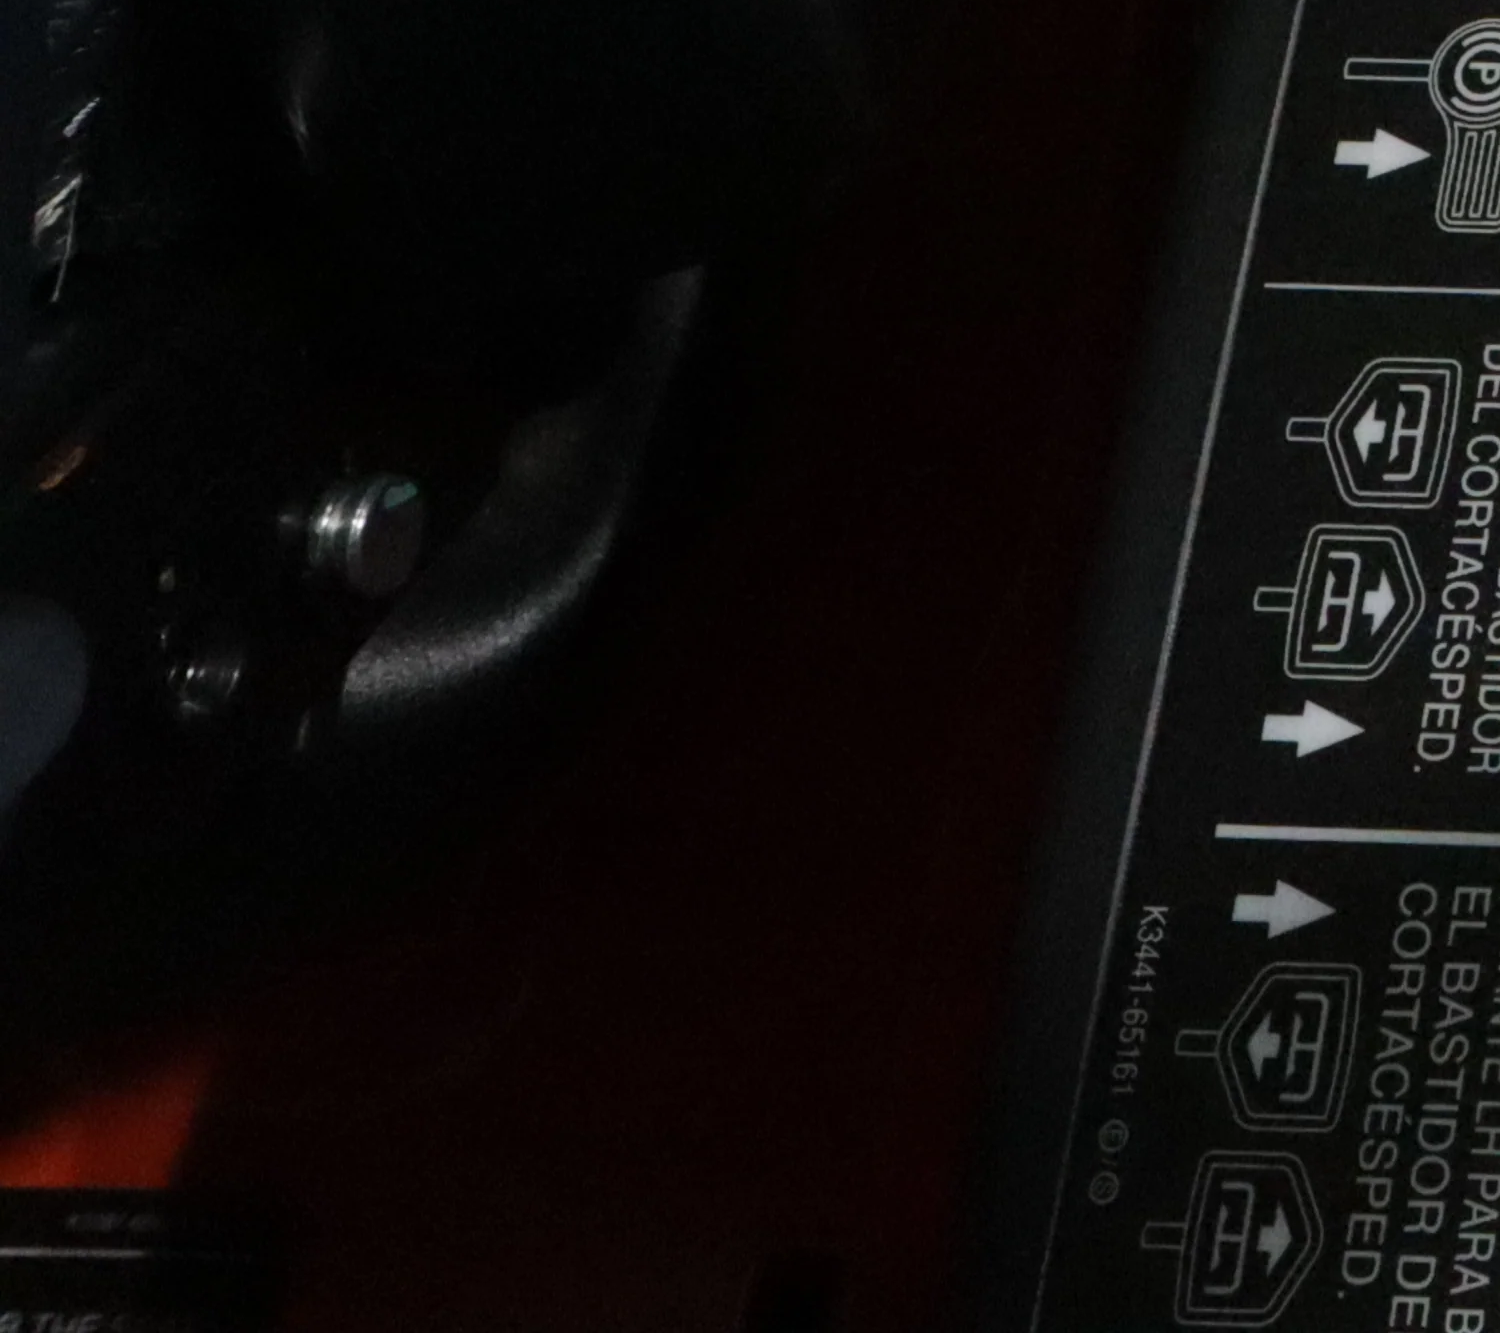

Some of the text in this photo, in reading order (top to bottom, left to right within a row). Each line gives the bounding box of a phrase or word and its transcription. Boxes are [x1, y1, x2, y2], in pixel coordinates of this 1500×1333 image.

[1110, 904, 1170, 1095] K3441-65161
[1336, 881, 1439, 1300] CORTACÉSPED.
[1388, 885, 1493, 1333] EL BASTIDOR DE
